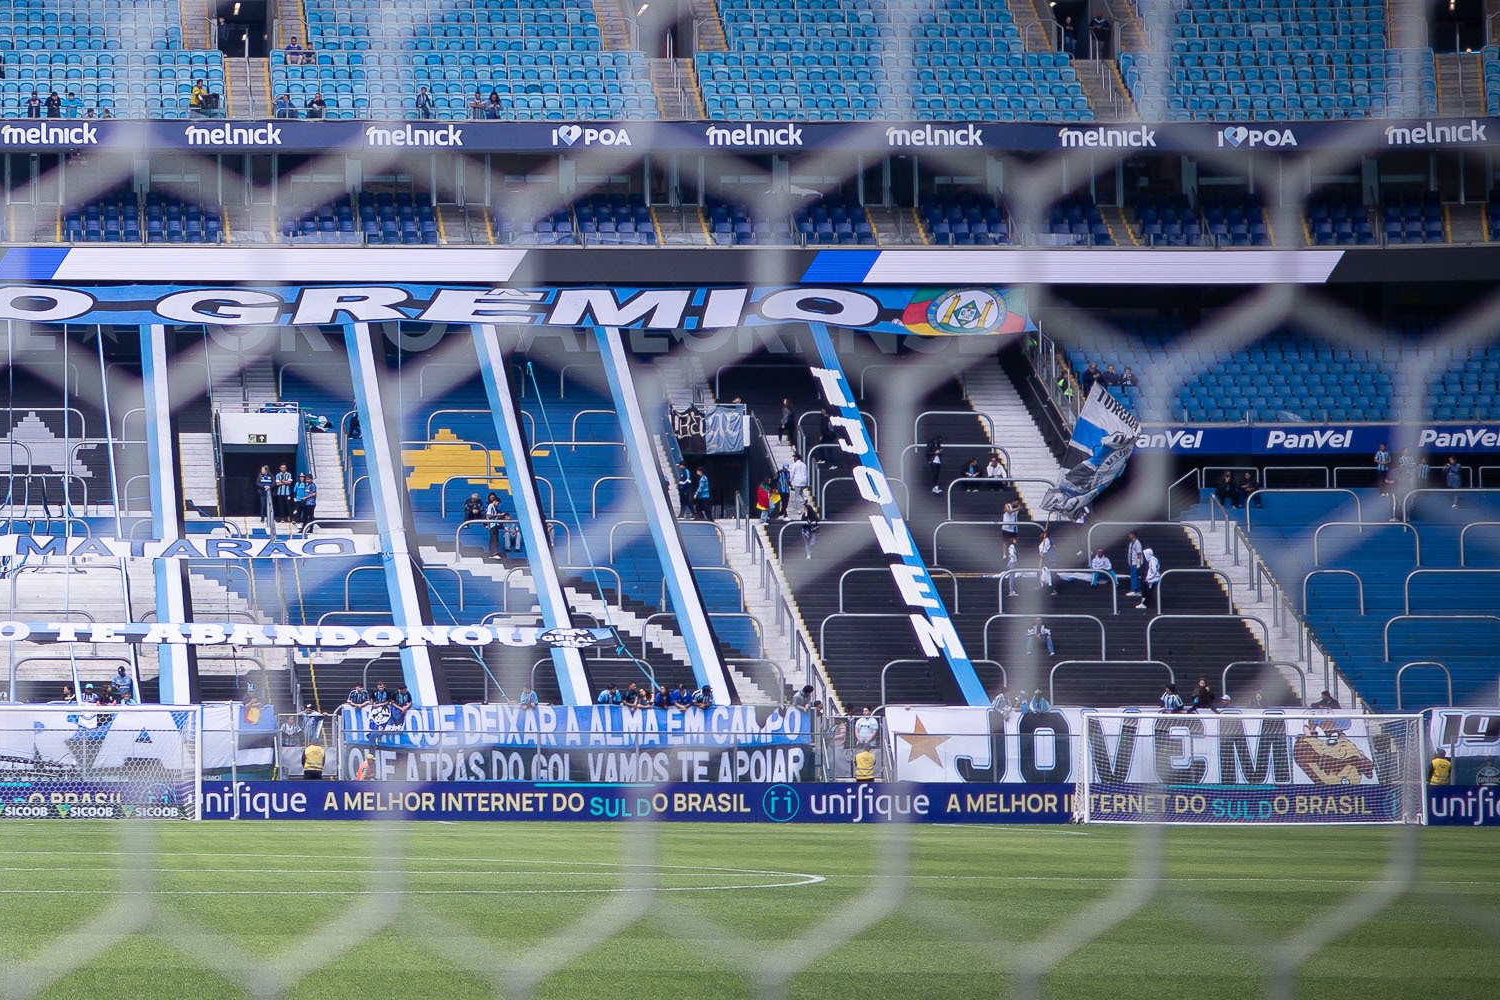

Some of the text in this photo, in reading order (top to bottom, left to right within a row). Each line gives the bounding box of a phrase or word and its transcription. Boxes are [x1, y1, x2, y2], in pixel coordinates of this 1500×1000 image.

[1, 122, 97, 145] melnick
[185, 122, 282, 145] melnick
[366, 123, 463, 146] melnick
[585, 127, 632, 145] POA
[706, 123, 803, 147] melnick
[885, 124, 983, 147] melnick
[1058, 125, 1156, 148] melnick
[1248, 129, 1298, 147] POA
[1385, 119, 1486, 145] melnick
[155, 286, 879, 328] GRÊMIO
[1134, 430, 1203, 449] anVel
[1267, 430, 1352, 448] PanVel
[47, 621, 128, 643] TE
[461, 705, 557, 746] DEIXAR
[565, 705, 582, 746] A
[589, 705, 660, 746] ALMA
[667, 706, 706, 745] EM
[587, 751, 670, 782] VAMOS
[677, 751, 710, 782] TE
[718, 747, 805, 782] APOIAR
[4, 804, 48, 816] SICOOB
[69, 804, 114, 816] SICOOB
[135, 805, 179, 817] SICOOB
[323, 792, 338, 811] A
[344, 792, 436, 812] MELHOR
[441, 792, 548, 812] INTERNET
[552, 792, 585, 812] DO
[589, 797, 633, 817] SUL
[674, 793, 751, 812] BRASIL
[946, 793, 962, 813] A
[967, 793, 1058, 813] MELHOR
[1174, 794, 1206, 814] DO
[1295, 795, 1373, 815] BRASIL
